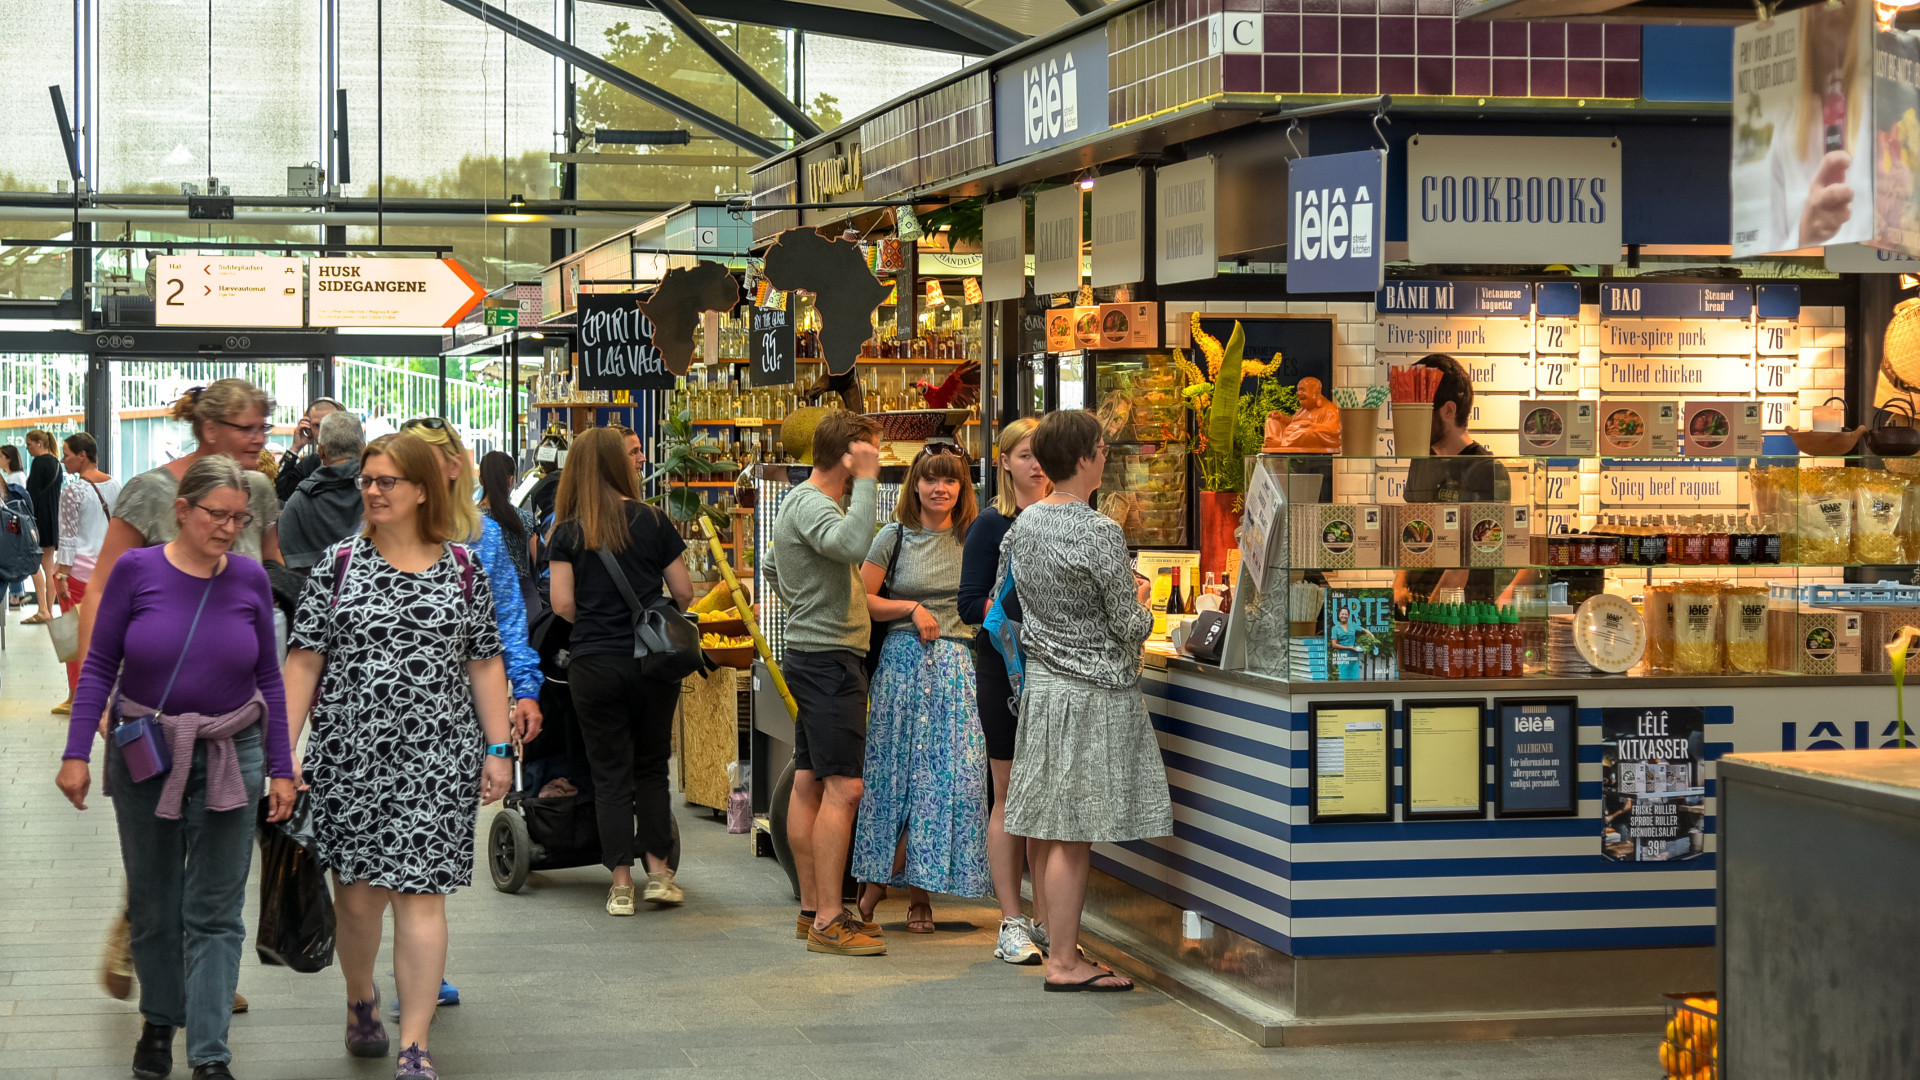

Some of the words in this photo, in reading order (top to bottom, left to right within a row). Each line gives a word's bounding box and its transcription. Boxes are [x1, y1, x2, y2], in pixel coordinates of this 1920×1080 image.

[1232, 19, 1255, 46] C
[1754, 35, 1772, 62] YOUR
[1164, 179, 1207, 217] VIETNAMESE
[1421, 175, 1607, 224] COOKBOOKS
[1294, 187, 1349, 261] lêlê
[701, 230, 714, 244] C
[1353, 245, 1370, 255] kitchen
[318, 266, 361, 277] HUSK
[166, 278, 185, 306] 2
[318, 280, 426, 293] SIDEGANGENE
[1386, 281, 1429, 310] BÁNH
[1435, 281, 1455, 310] MÌ
[1481, 288, 1522, 299] Vietnamese
[1704, 289, 1734, 301] Steamed
[1481, 299, 1513, 312] baguette
[1611, 288, 1641, 311] BAO
[1704, 301, 1725, 312] bread
[582, 307, 656, 347] SPIRITU
[1388, 324, 1452, 350] Five-spice
[1457, 325, 1485, 349] pork
[1611, 326, 1674, 351] Five-spice
[1678, 327, 1706, 351] pork
[1469, 363, 1496, 383] beef
[1611, 363, 1650, 384] Pulled
[1655, 364, 1702, 384] chicken
[1610, 476, 1644, 501] Spicy
[1650, 476, 1676, 496] beef
[1680, 479, 1722, 500] ragout
[1332, 597, 1389, 626] URTE
[1638, 710, 1669, 737] LÊLÊ
[1517, 743, 1554, 754] ALLERGENER
[1618, 738, 1689, 760] KITKASSER
[1510, 757, 1519, 767] For
[1520, 757, 1550, 767] information
[1551, 759, 1560, 767] om
[1631, 805, 1653, 815] FRISKE
[1654, 805, 1677, 815] RULLER
[1630, 816, 1654, 827] SPRØDE
[1655, 815, 1678, 826] RULLER
[1630, 826, 1678, 838] RISNUDELSALAT
